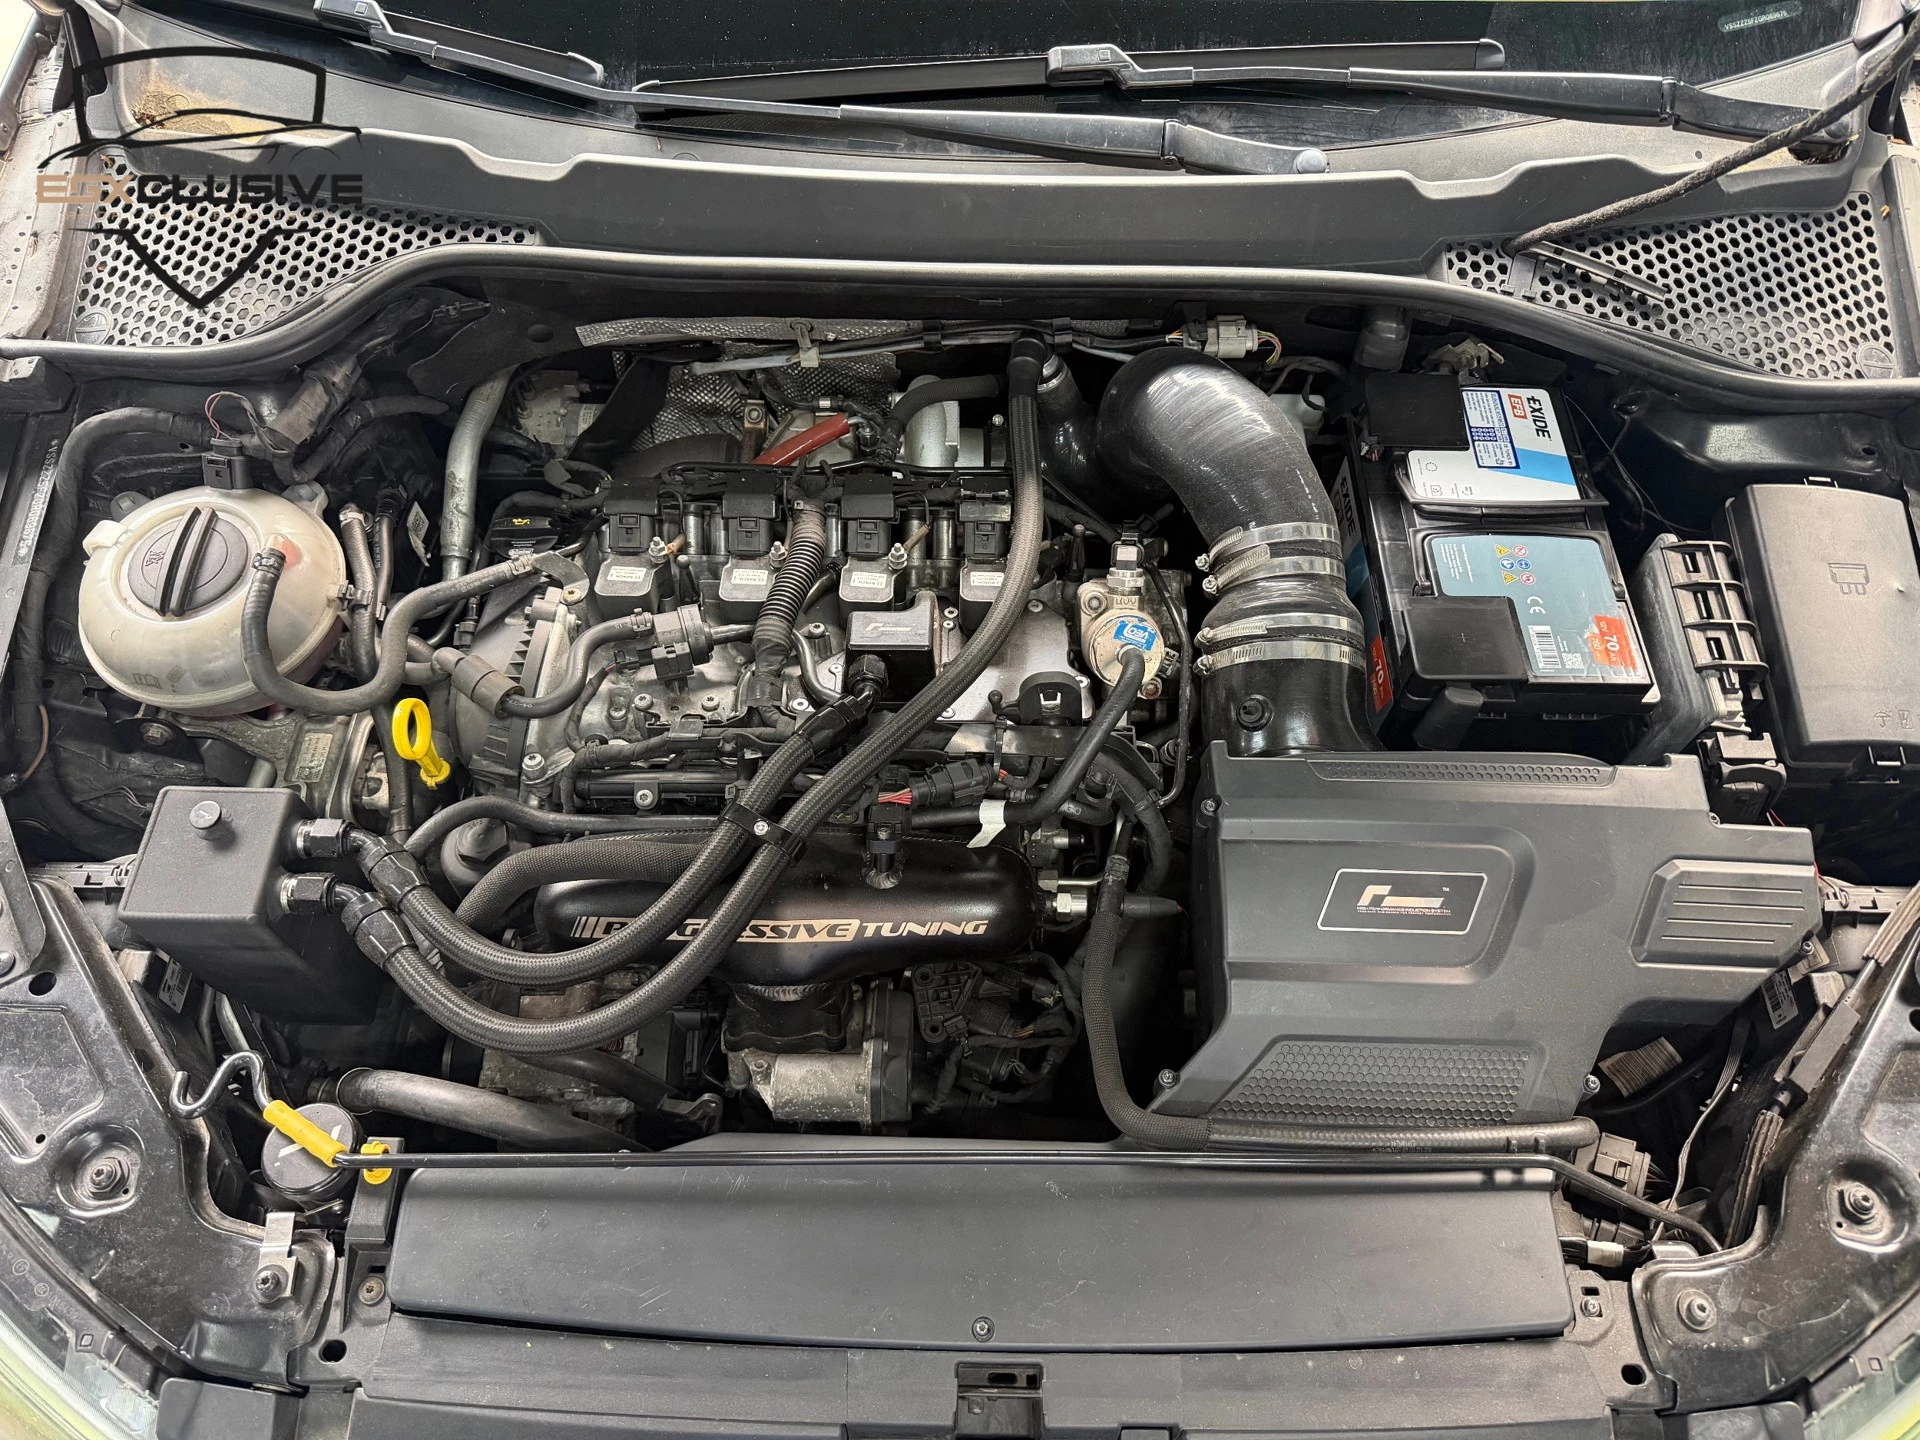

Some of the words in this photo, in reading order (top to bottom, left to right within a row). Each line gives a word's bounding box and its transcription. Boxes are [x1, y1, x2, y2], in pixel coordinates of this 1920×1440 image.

[1510, 397, 1525, 416] EFB
[1527, 395, 1552, 438] EXIDE
[1338, 477, 1357, 537] EXIDE
[1592, 637, 1602, 650] 760
[1599, 620, 1609, 632] 12V
[1605, 634, 1620, 650] 70
[1374, 659, 1385, 684] 70
[861, 919, 989, 938] TUNING
